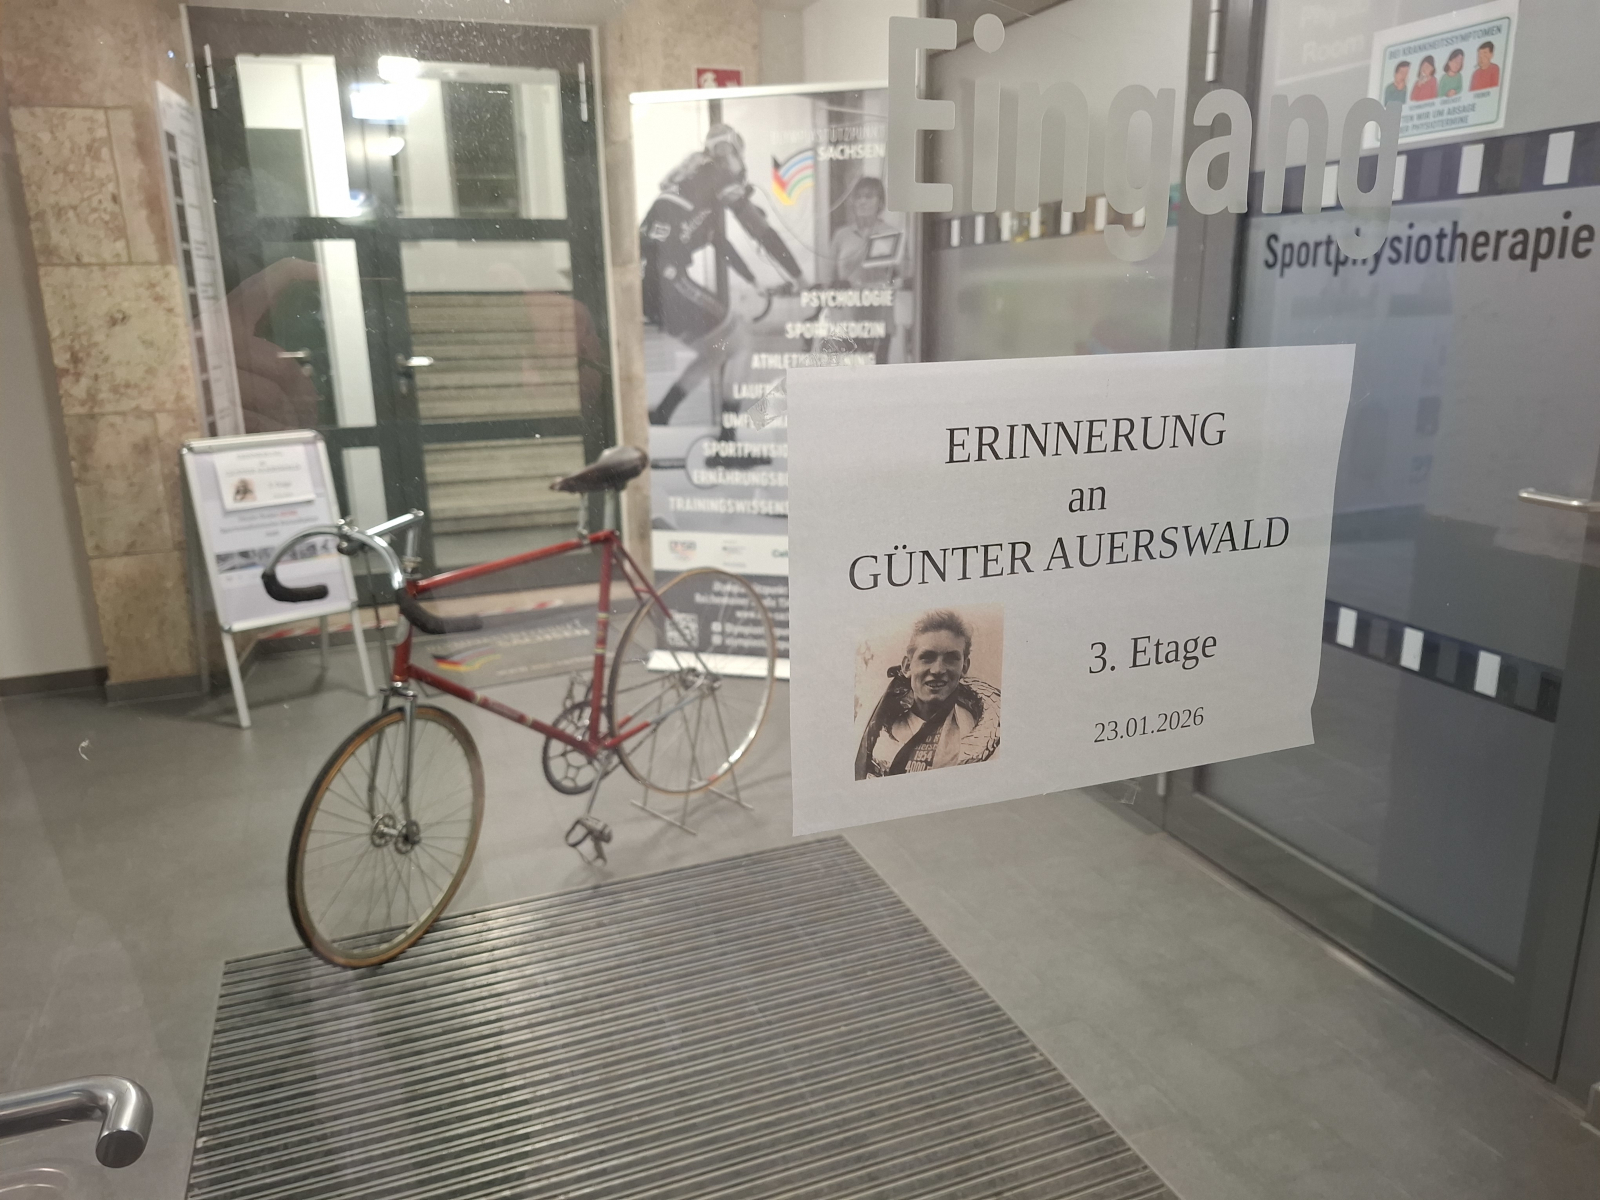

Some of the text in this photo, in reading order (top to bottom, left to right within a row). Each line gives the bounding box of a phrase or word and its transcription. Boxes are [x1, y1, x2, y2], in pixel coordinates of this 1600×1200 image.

[1447, 103, 1477, 115] ABSAGE
[817, 142, 886, 161] SACHSEN
[887, 13, 1400, 262] Eingang
[1264, 211, 1595, 278] Sportpysiotherapie
[801, 289, 894, 308] PSYCHOLOGIE
[945, 412, 1227, 464] ERINNERUNG
[1068, 485, 1107, 513] an
[849, 516, 1291, 591] GÜNTER AUERSWALD
[1089, 634, 1217, 674] 3. Etage
[1093, 706, 1205, 743] 23.01.2026
[914, 750, 933, 761] 1954
